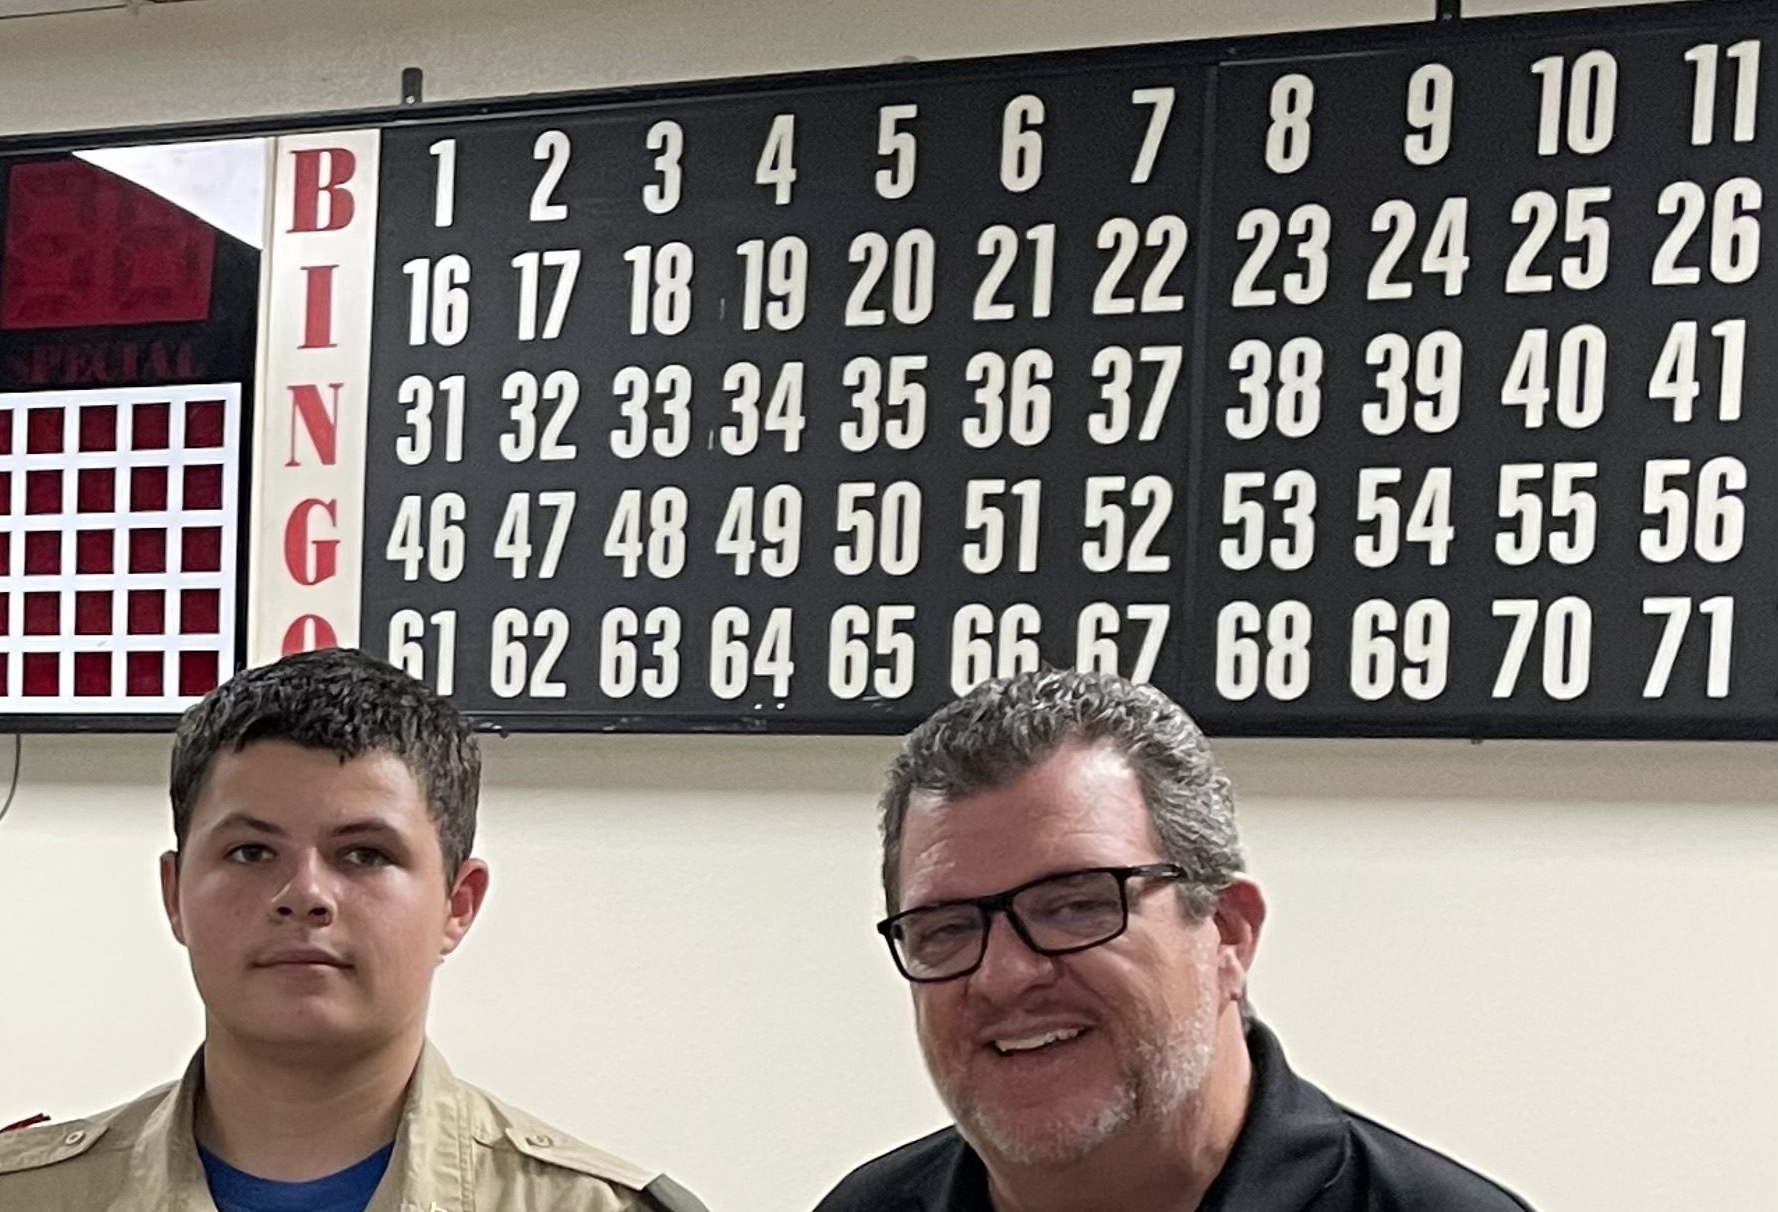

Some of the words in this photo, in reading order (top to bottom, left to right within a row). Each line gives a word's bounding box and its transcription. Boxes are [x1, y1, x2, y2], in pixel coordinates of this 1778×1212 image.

[429, 138, 456, 228] 1
[529, 130, 571, 222] 2
[642, 120, 683, 214] 3
[755, 114, 797, 205] 4
[875, 104, 918, 199] 5
[1000, 94, 1045, 193] 6
[1130, 87, 1175, 184] 7
[1265, 73, 1314, 174] 8
[1404, 63, 1453, 165] 9
[1531, 49, 1618, 156] 10
[1684, 39, 1761, 146] 11
[402, 254, 471, 347] 16
[510, 249, 581, 341] 17
[623, 241, 693, 336] 18
[736, 236, 808, 331] 19
[844, 228, 935, 327] 20
[972, 223, 1056, 321] 21
[1092, 215, 1188, 315] 22
[1231, 203, 1331, 308] 23
[1366, 197, 1470, 301] 24
[1505, 186, 1612, 293] 25
[1651, 177, 1763, 286] 26
[395, 375, 466, 466] 31
[499, 369, 580, 463] 32
[609, 364, 692, 459] 33
[720, 361, 806, 456] 34
[839, 355, 928, 452] 35
[962, 348, 1053, 449] 36
[1087, 345, 1183, 445] 37
[1225, 336, 1324, 440] 38
[1361, 330, 1463, 436] 39
[1500, 323, 1607, 429] 40
[1648, 319, 1746, 423] 41
[385, 492, 466, 582] 46
[493, 490, 576, 579] 47
[603, 486, 688, 579] 48
[715, 484, 803, 578] 49
[833, 480, 922, 576] 50
[962, 479, 1042, 574] 51
[1081, 475, 1174, 573] 52
[1219, 469, 1317, 571] 53
[1354, 467, 1455, 568] 54
[1495, 461, 1598, 566] 55
[1639, 456, 1748, 563] 56
[387, 609, 457, 697] 61
[490, 607, 570, 698] 62
[599, 606, 681, 699] 63
[709, 606, 795, 700] 64
[828, 604, 916, 700] 65
[950, 603, 1042, 698] 66
[1075, 601, 1171, 685] 67
[1215, 599, 1312, 701] 68
[1350, 598, 1450, 701] 69
[1491, 595, 1592, 700] 70
[1642, 595, 1735, 698] 71
